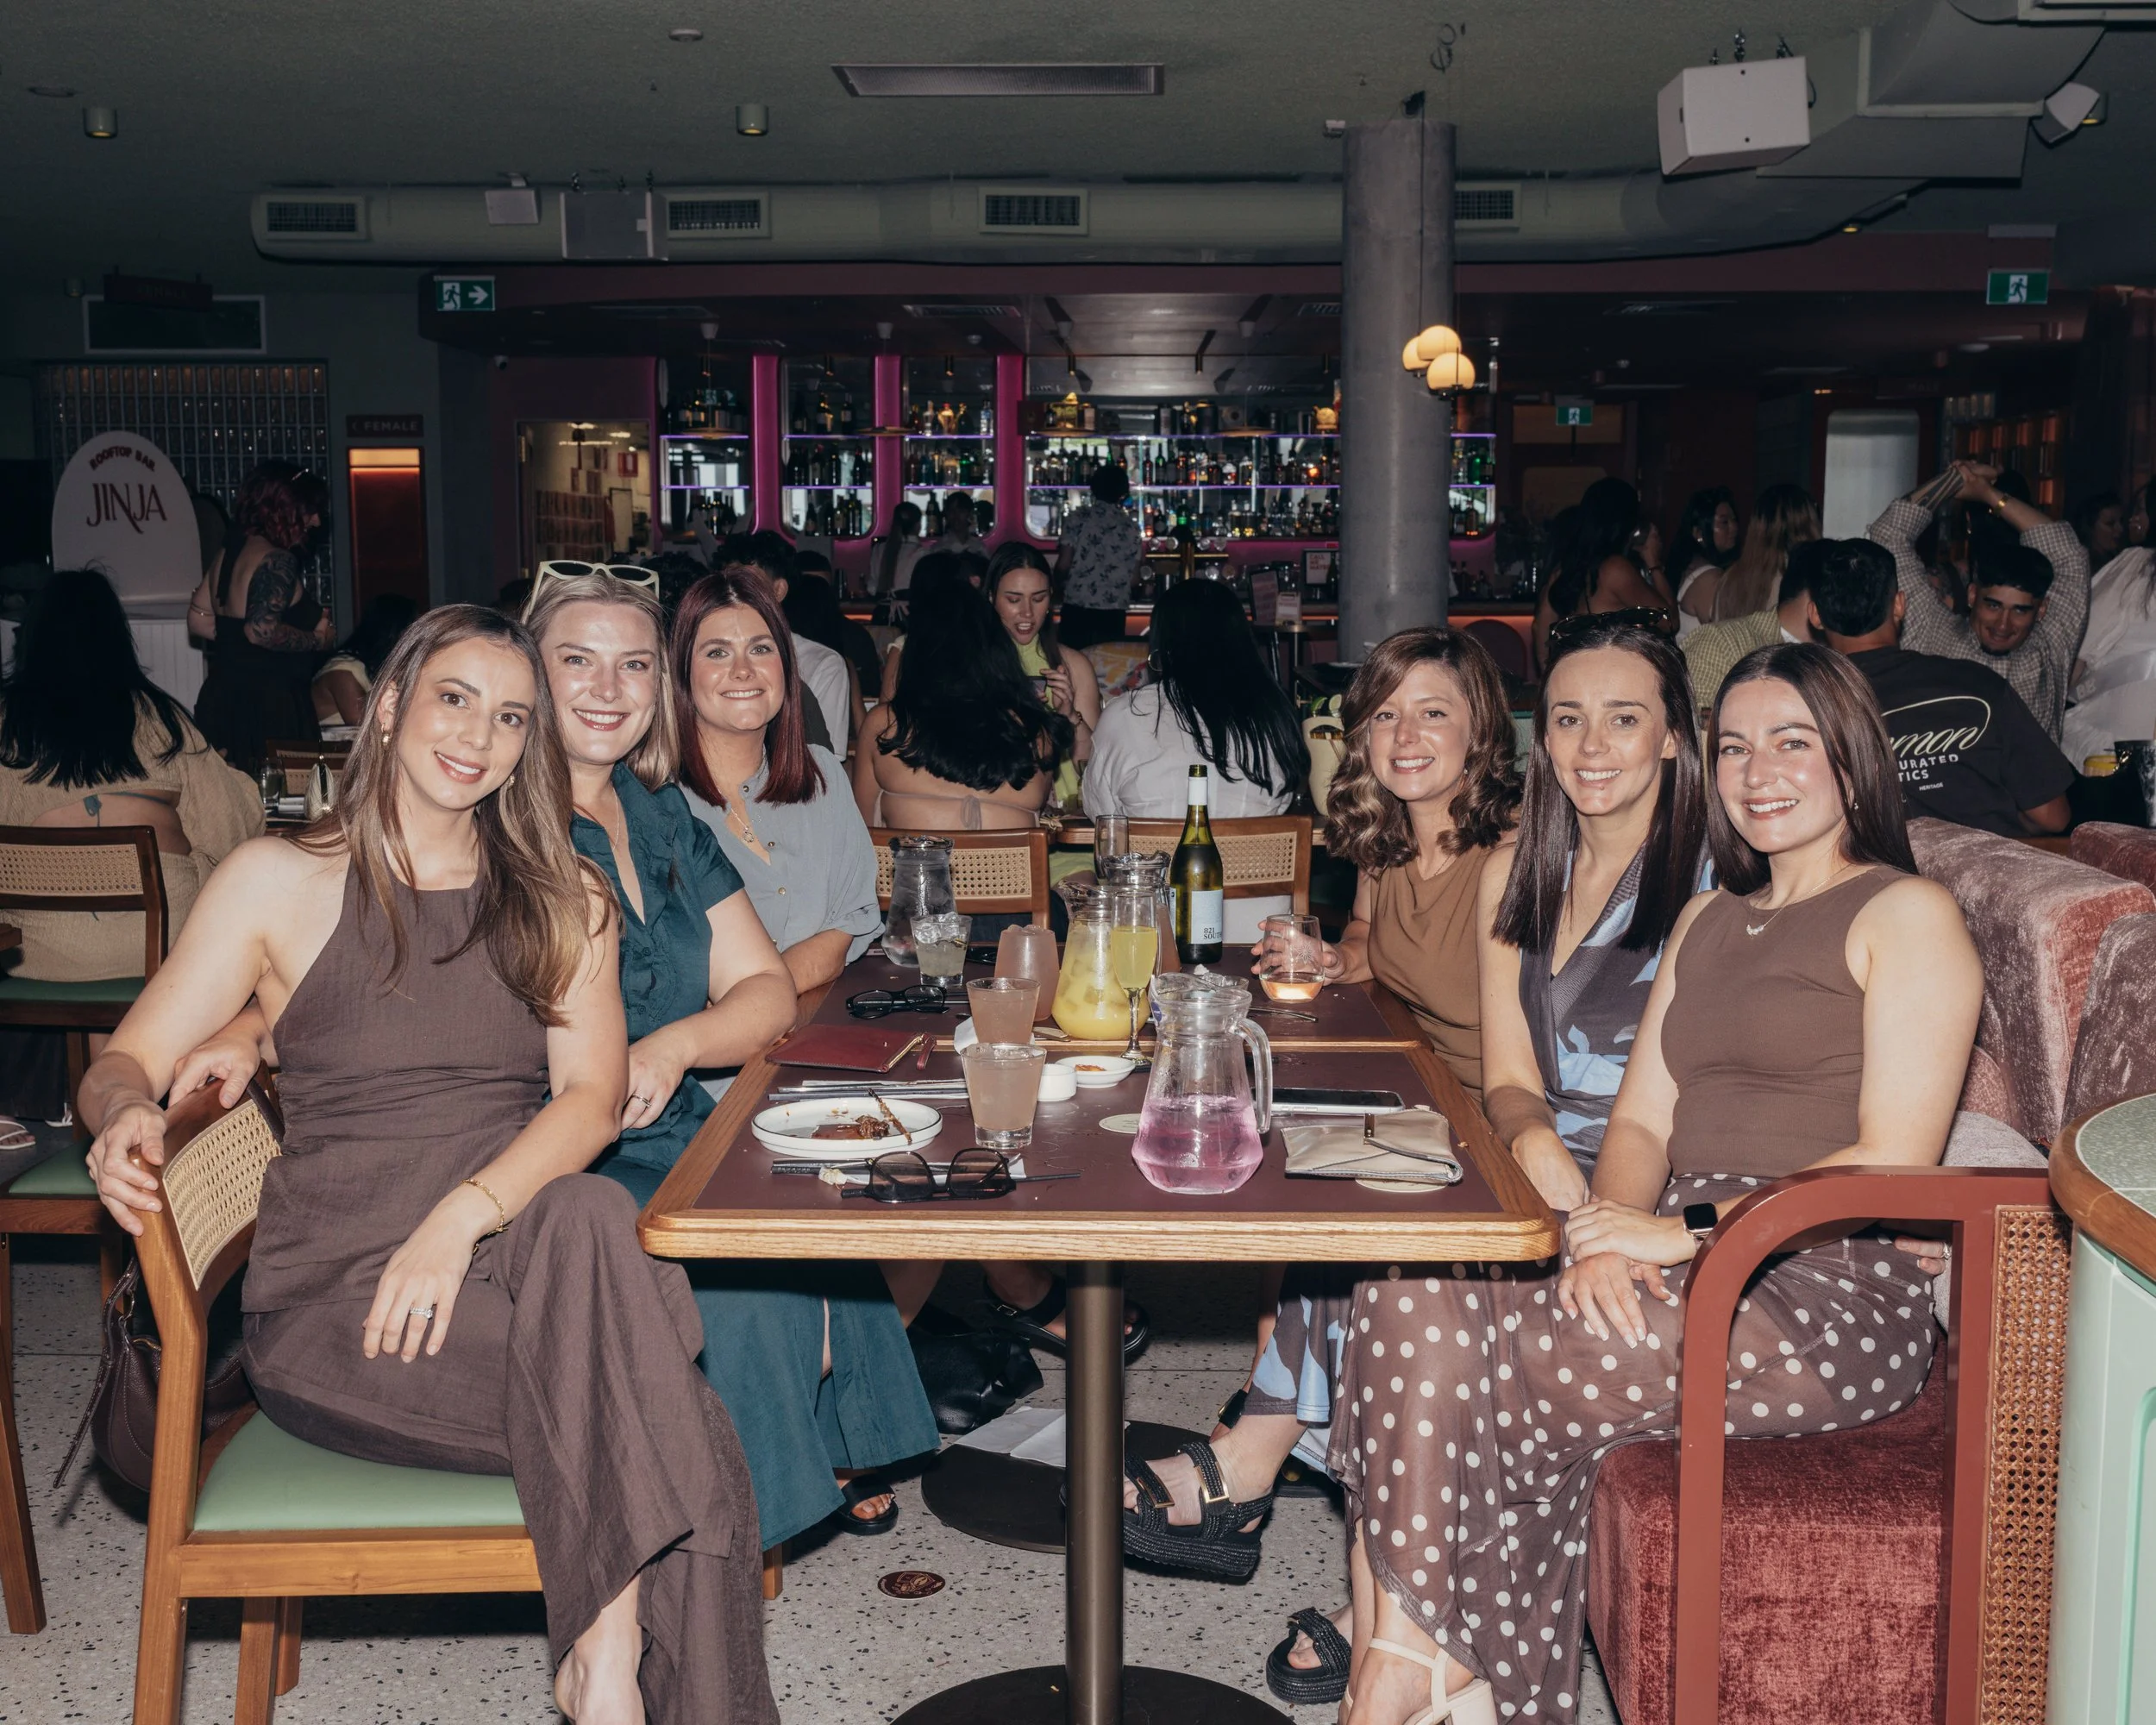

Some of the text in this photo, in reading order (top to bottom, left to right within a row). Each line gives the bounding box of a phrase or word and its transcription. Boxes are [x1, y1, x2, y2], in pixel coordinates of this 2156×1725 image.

[364, 421, 418, 431] FEMALE
[90, 445, 155, 473] ROOFTOP BAR
[86, 483, 166, 534] JINJA
[1898, 754, 1959, 770] URATED
[1897, 769, 1929, 782] TICS
[1919, 781, 1944, 791] HERITAGE
